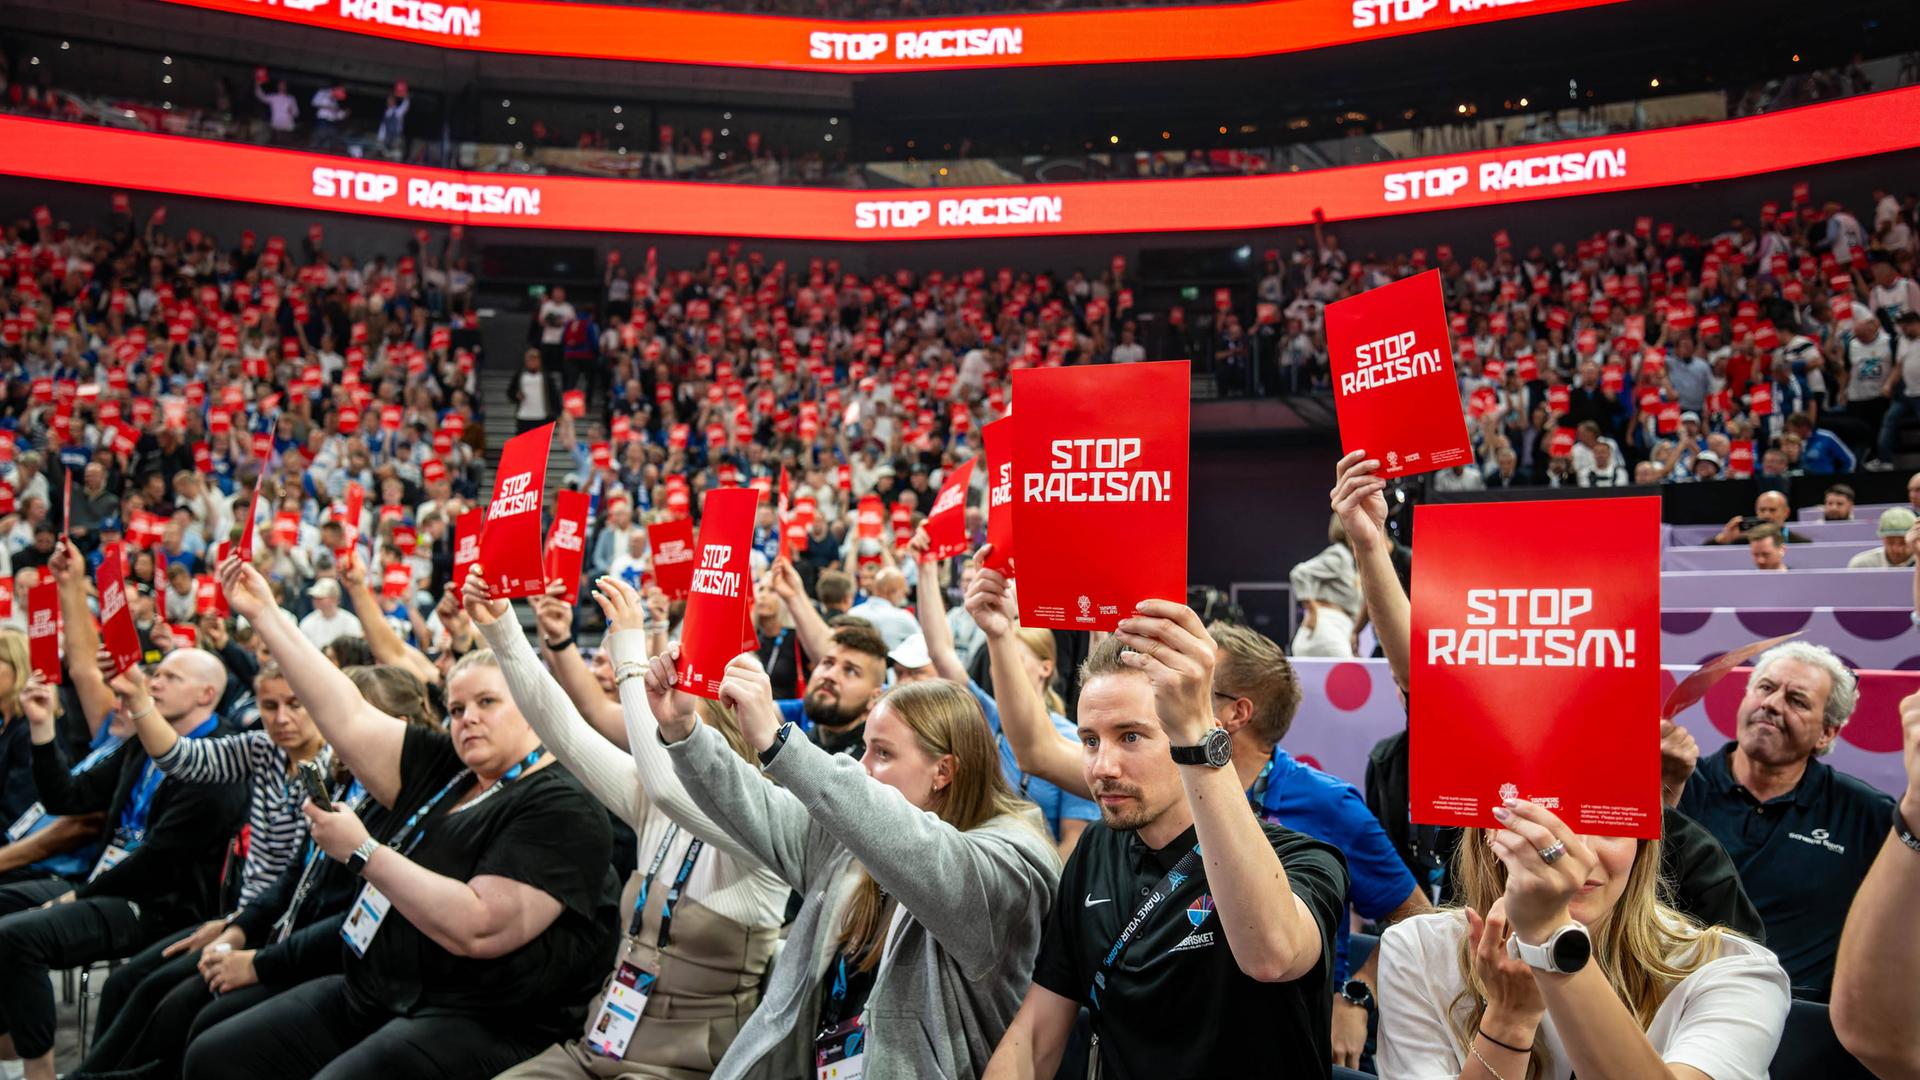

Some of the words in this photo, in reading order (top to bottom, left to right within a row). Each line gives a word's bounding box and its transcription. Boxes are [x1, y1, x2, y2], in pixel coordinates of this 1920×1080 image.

[340, 0, 481, 37] RACISM!
[809, 31, 888, 61] STOP
[895, 27, 1023, 60] RACISM!
[311, 166, 399, 204] STOP
[407, 178, 542, 216] RACISM!
[1382, 165, 1469, 203] STOP
[1478, 147, 1627, 193] RACISM!
[854, 201, 932, 229] STOP
[938, 196, 1063, 227] RACISM!
[1355, 331, 1416, 368] STOP
[1341, 348, 1443, 396] RACISM!
[1051, 437, 1141, 470] STOP
[499, 471, 532, 498] STOP
[1023, 470, 1171, 503] RACISM!
[488, 489, 538, 521] RACISM!
[700, 544, 732, 569] STOP
[690, 568, 741, 598] RACISM!
[1465, 588, 1592, 626] STOP
[1427, 628, 1636, 668] RACISM!
[1137, 891, 1161, 920] MAKE
[1121, 916, 1143, 943] YOUR
[1106, 938, 1124, 967] MARK
